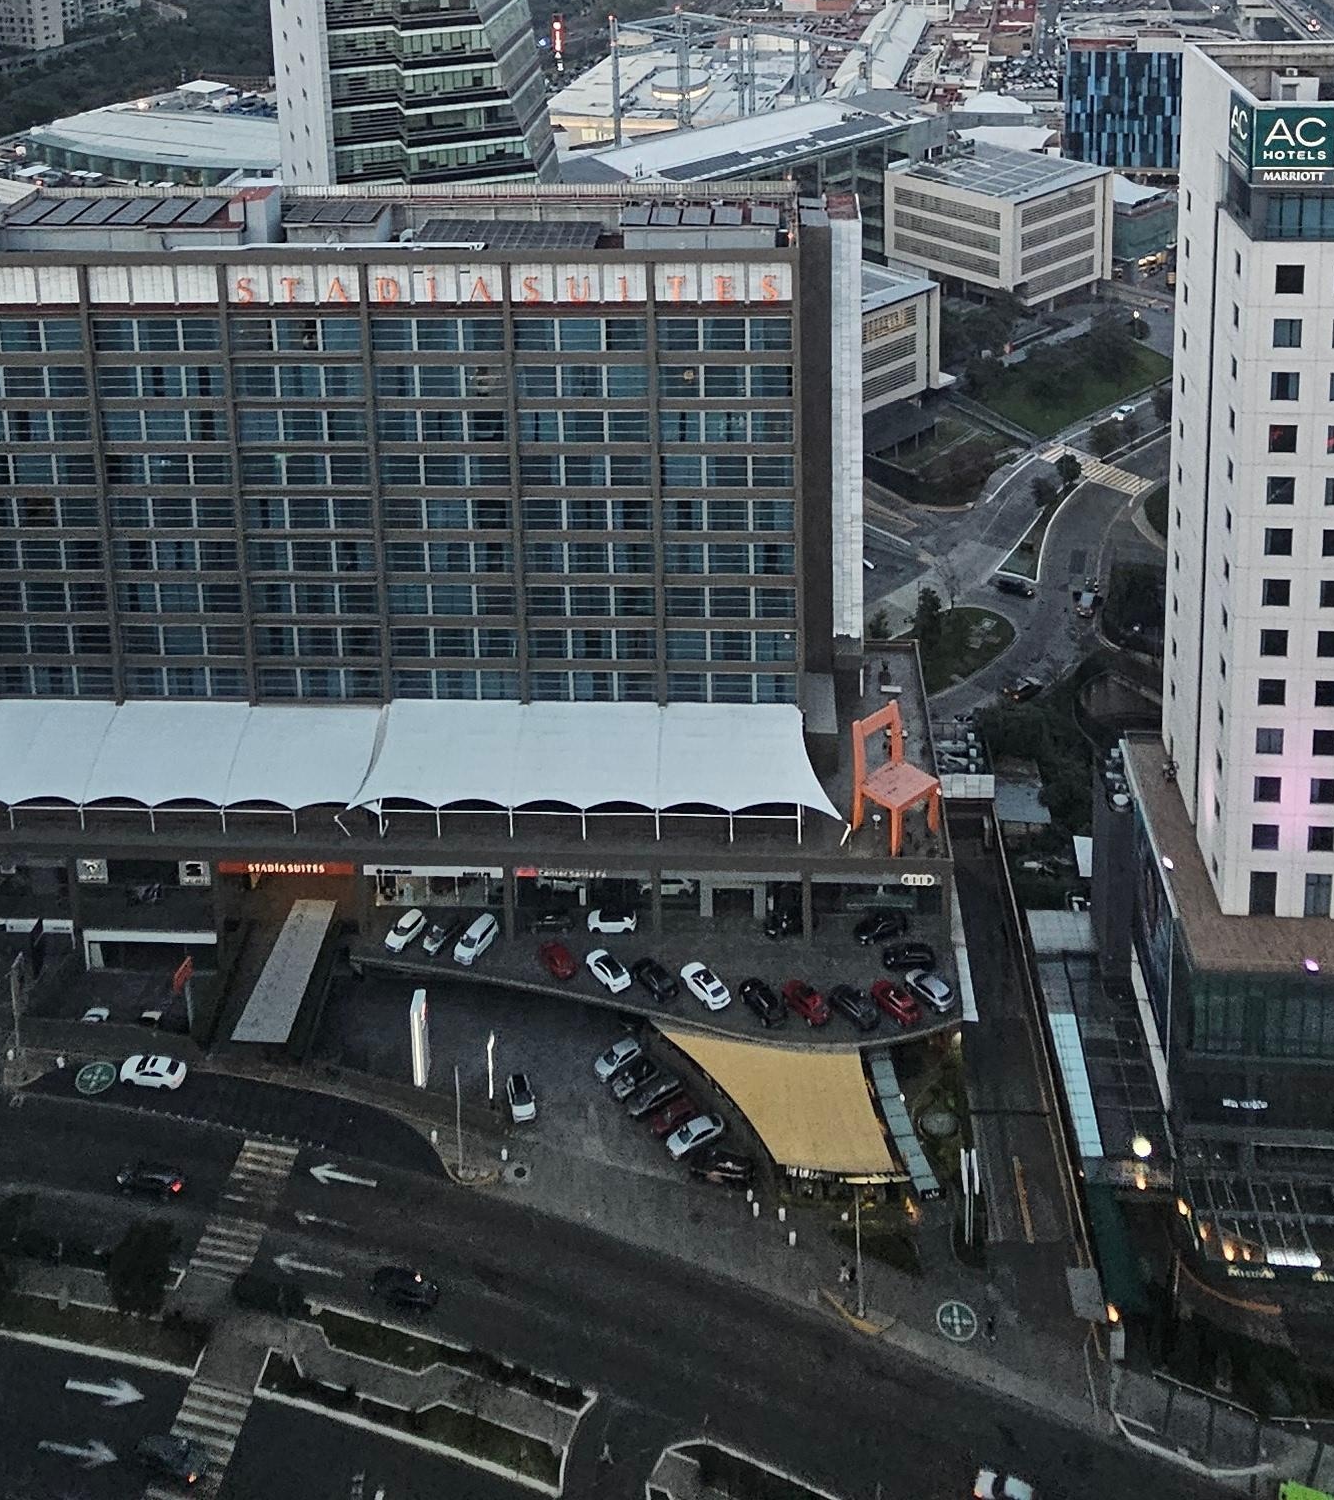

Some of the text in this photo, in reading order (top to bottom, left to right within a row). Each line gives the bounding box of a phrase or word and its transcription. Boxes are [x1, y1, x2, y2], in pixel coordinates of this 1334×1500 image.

[1231, 105, 1248, 140] AC
[1264, 117, 1327, 147] AC
[1263, 150, 1327, 161] HOTELS
[1263, 170, 1325, 181] MARRIOTT
